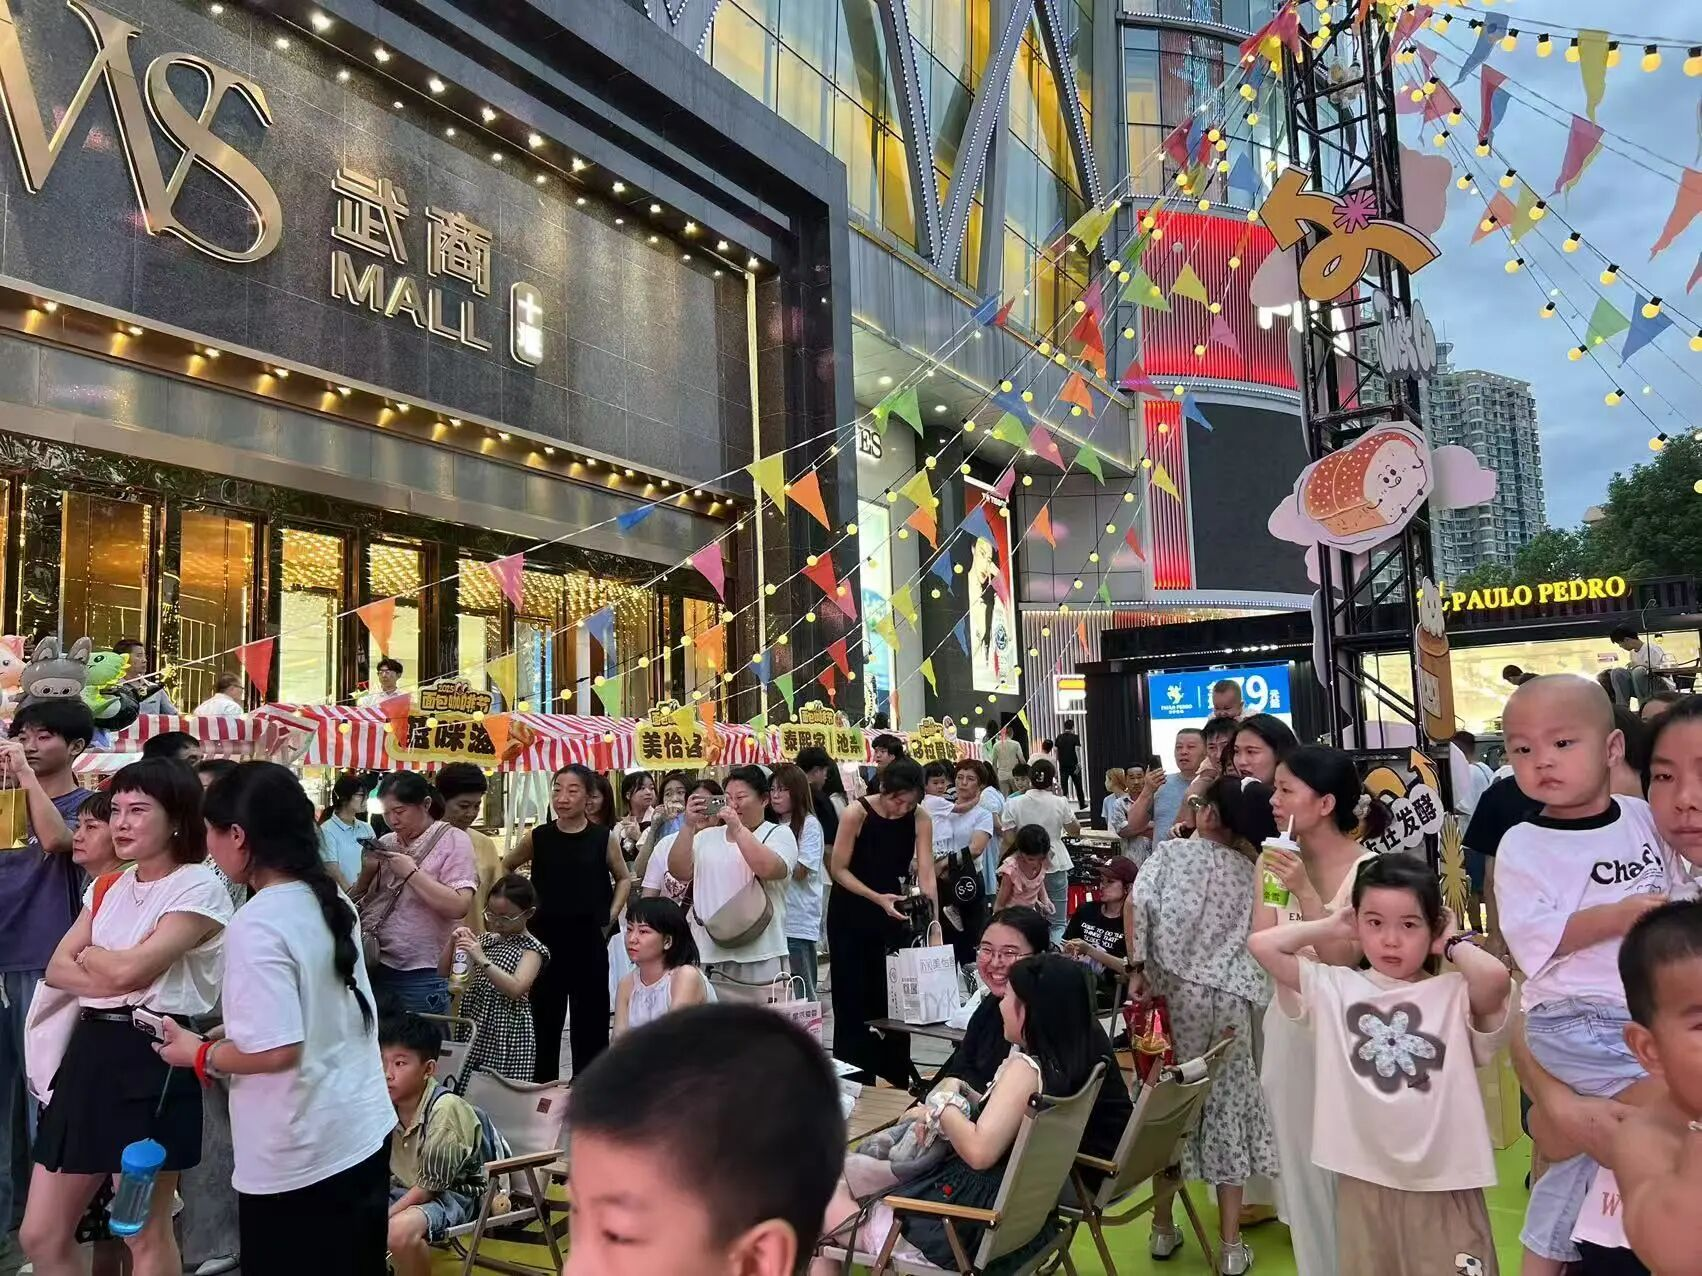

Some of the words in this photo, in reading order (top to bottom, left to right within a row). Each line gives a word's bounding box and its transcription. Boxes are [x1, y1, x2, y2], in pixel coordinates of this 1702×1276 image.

[331, 168, 493, 297] 武商
[331, 250, 493, 351] MALL
[1451, 584, 1533, 612] PAULO
[1538, 575, 1627, 604] PEDRO
[420, 690, 491, 714] 面包咖啡节
